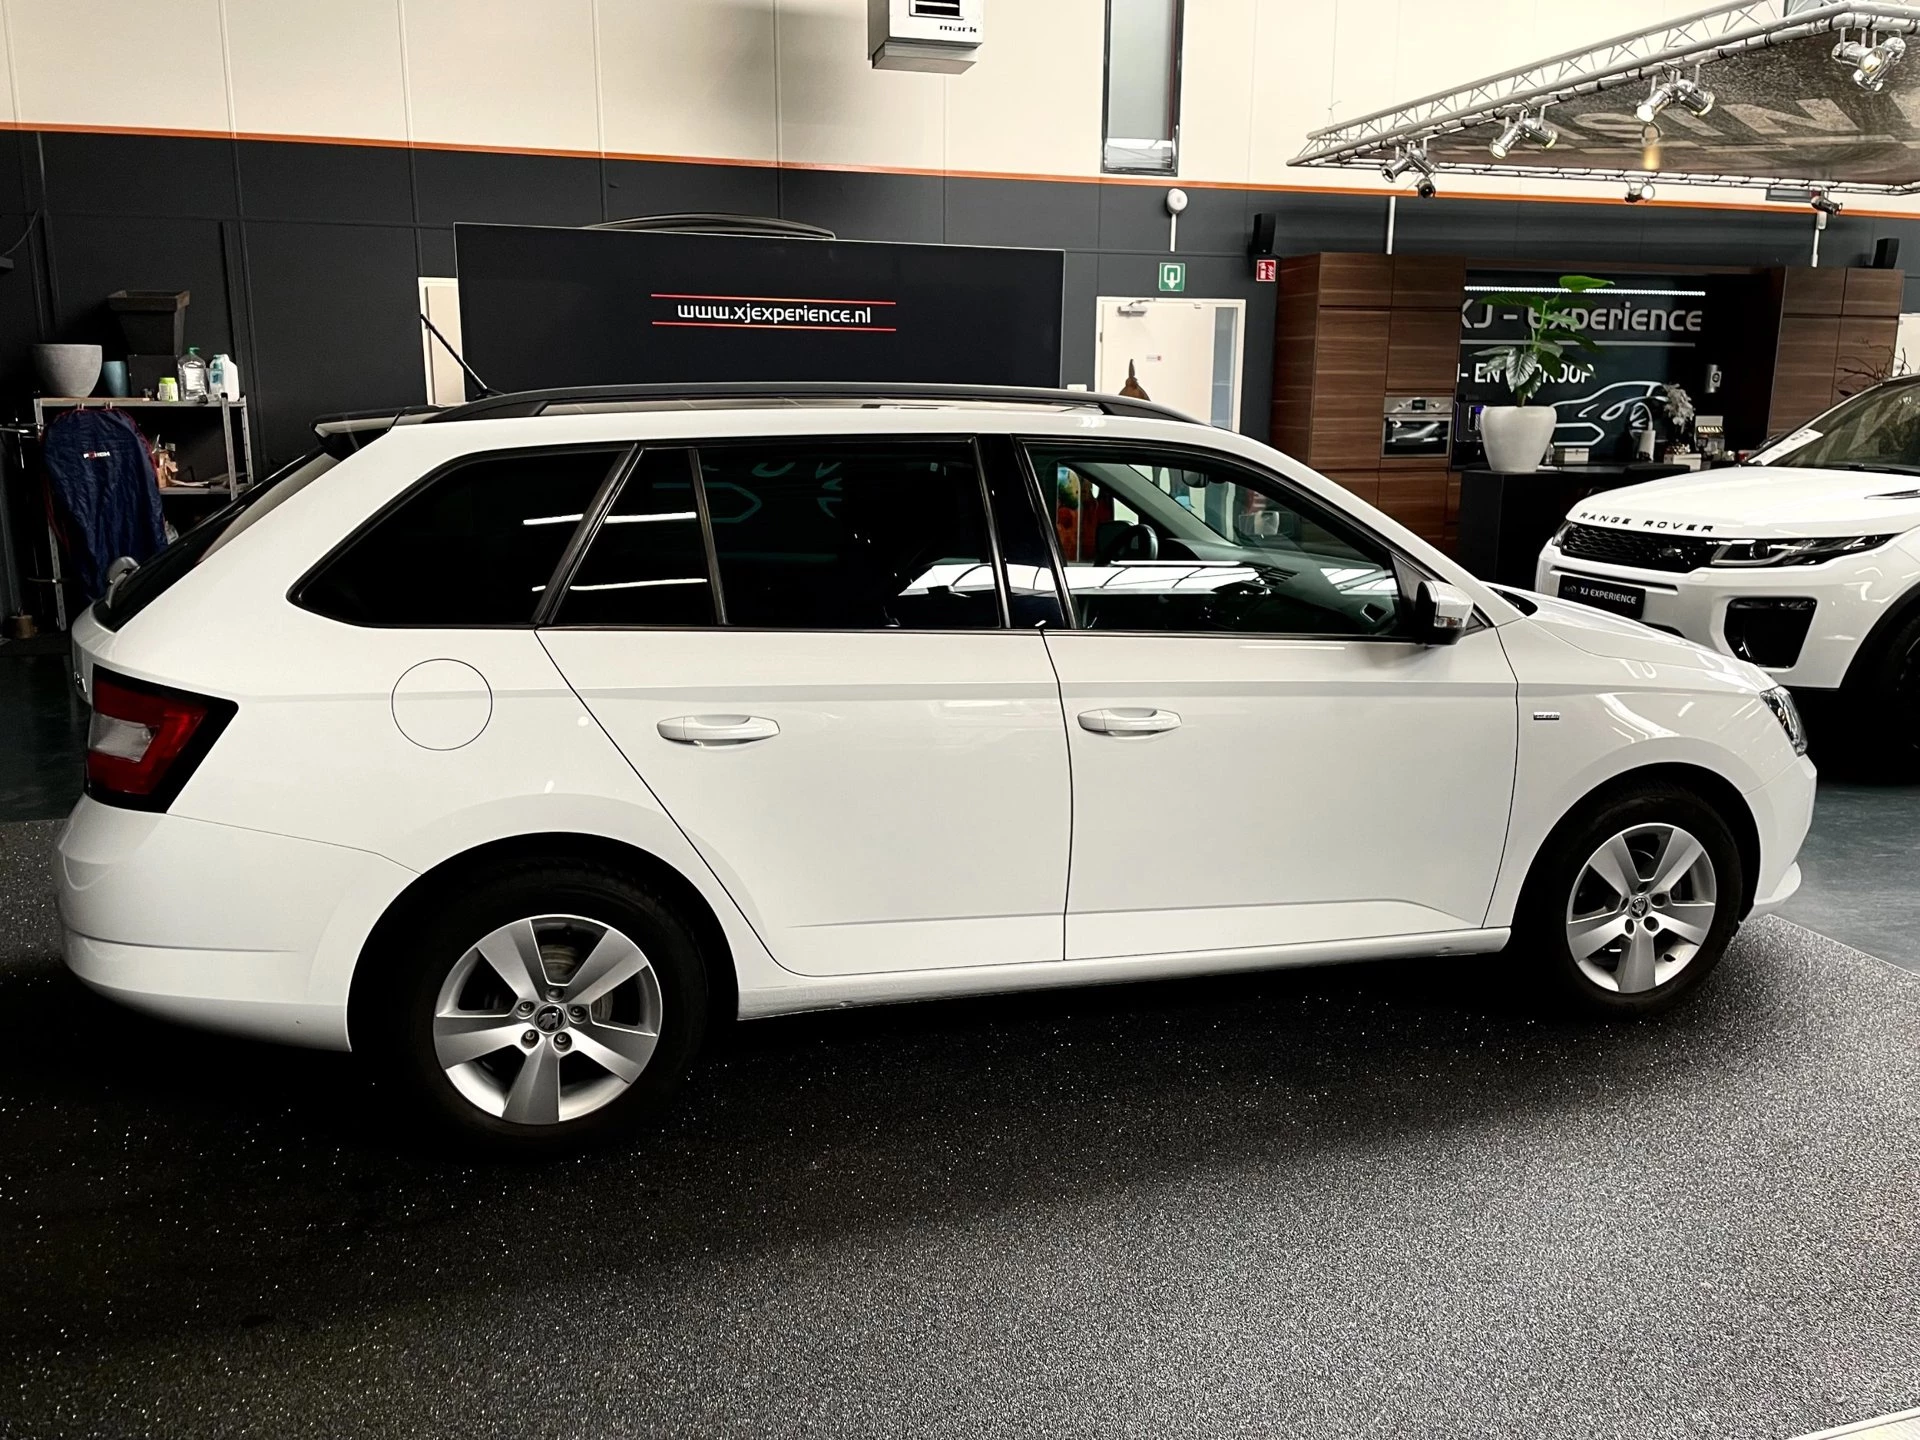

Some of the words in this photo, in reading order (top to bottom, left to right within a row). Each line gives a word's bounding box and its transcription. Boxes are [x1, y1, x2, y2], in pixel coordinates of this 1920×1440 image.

[939, 25, 977, 33] mark
[677, 303, 871, 324] www.xjexperience.nl
[1474, 363, 1500, 383] EN
[1579, 512, 1632, 525] RANGE
[1643, 520, 1714, 533] ROVER
[1579, 586, 1589, 595] XJ
[1590, 588, 1637, 605] EXPERIENCE
